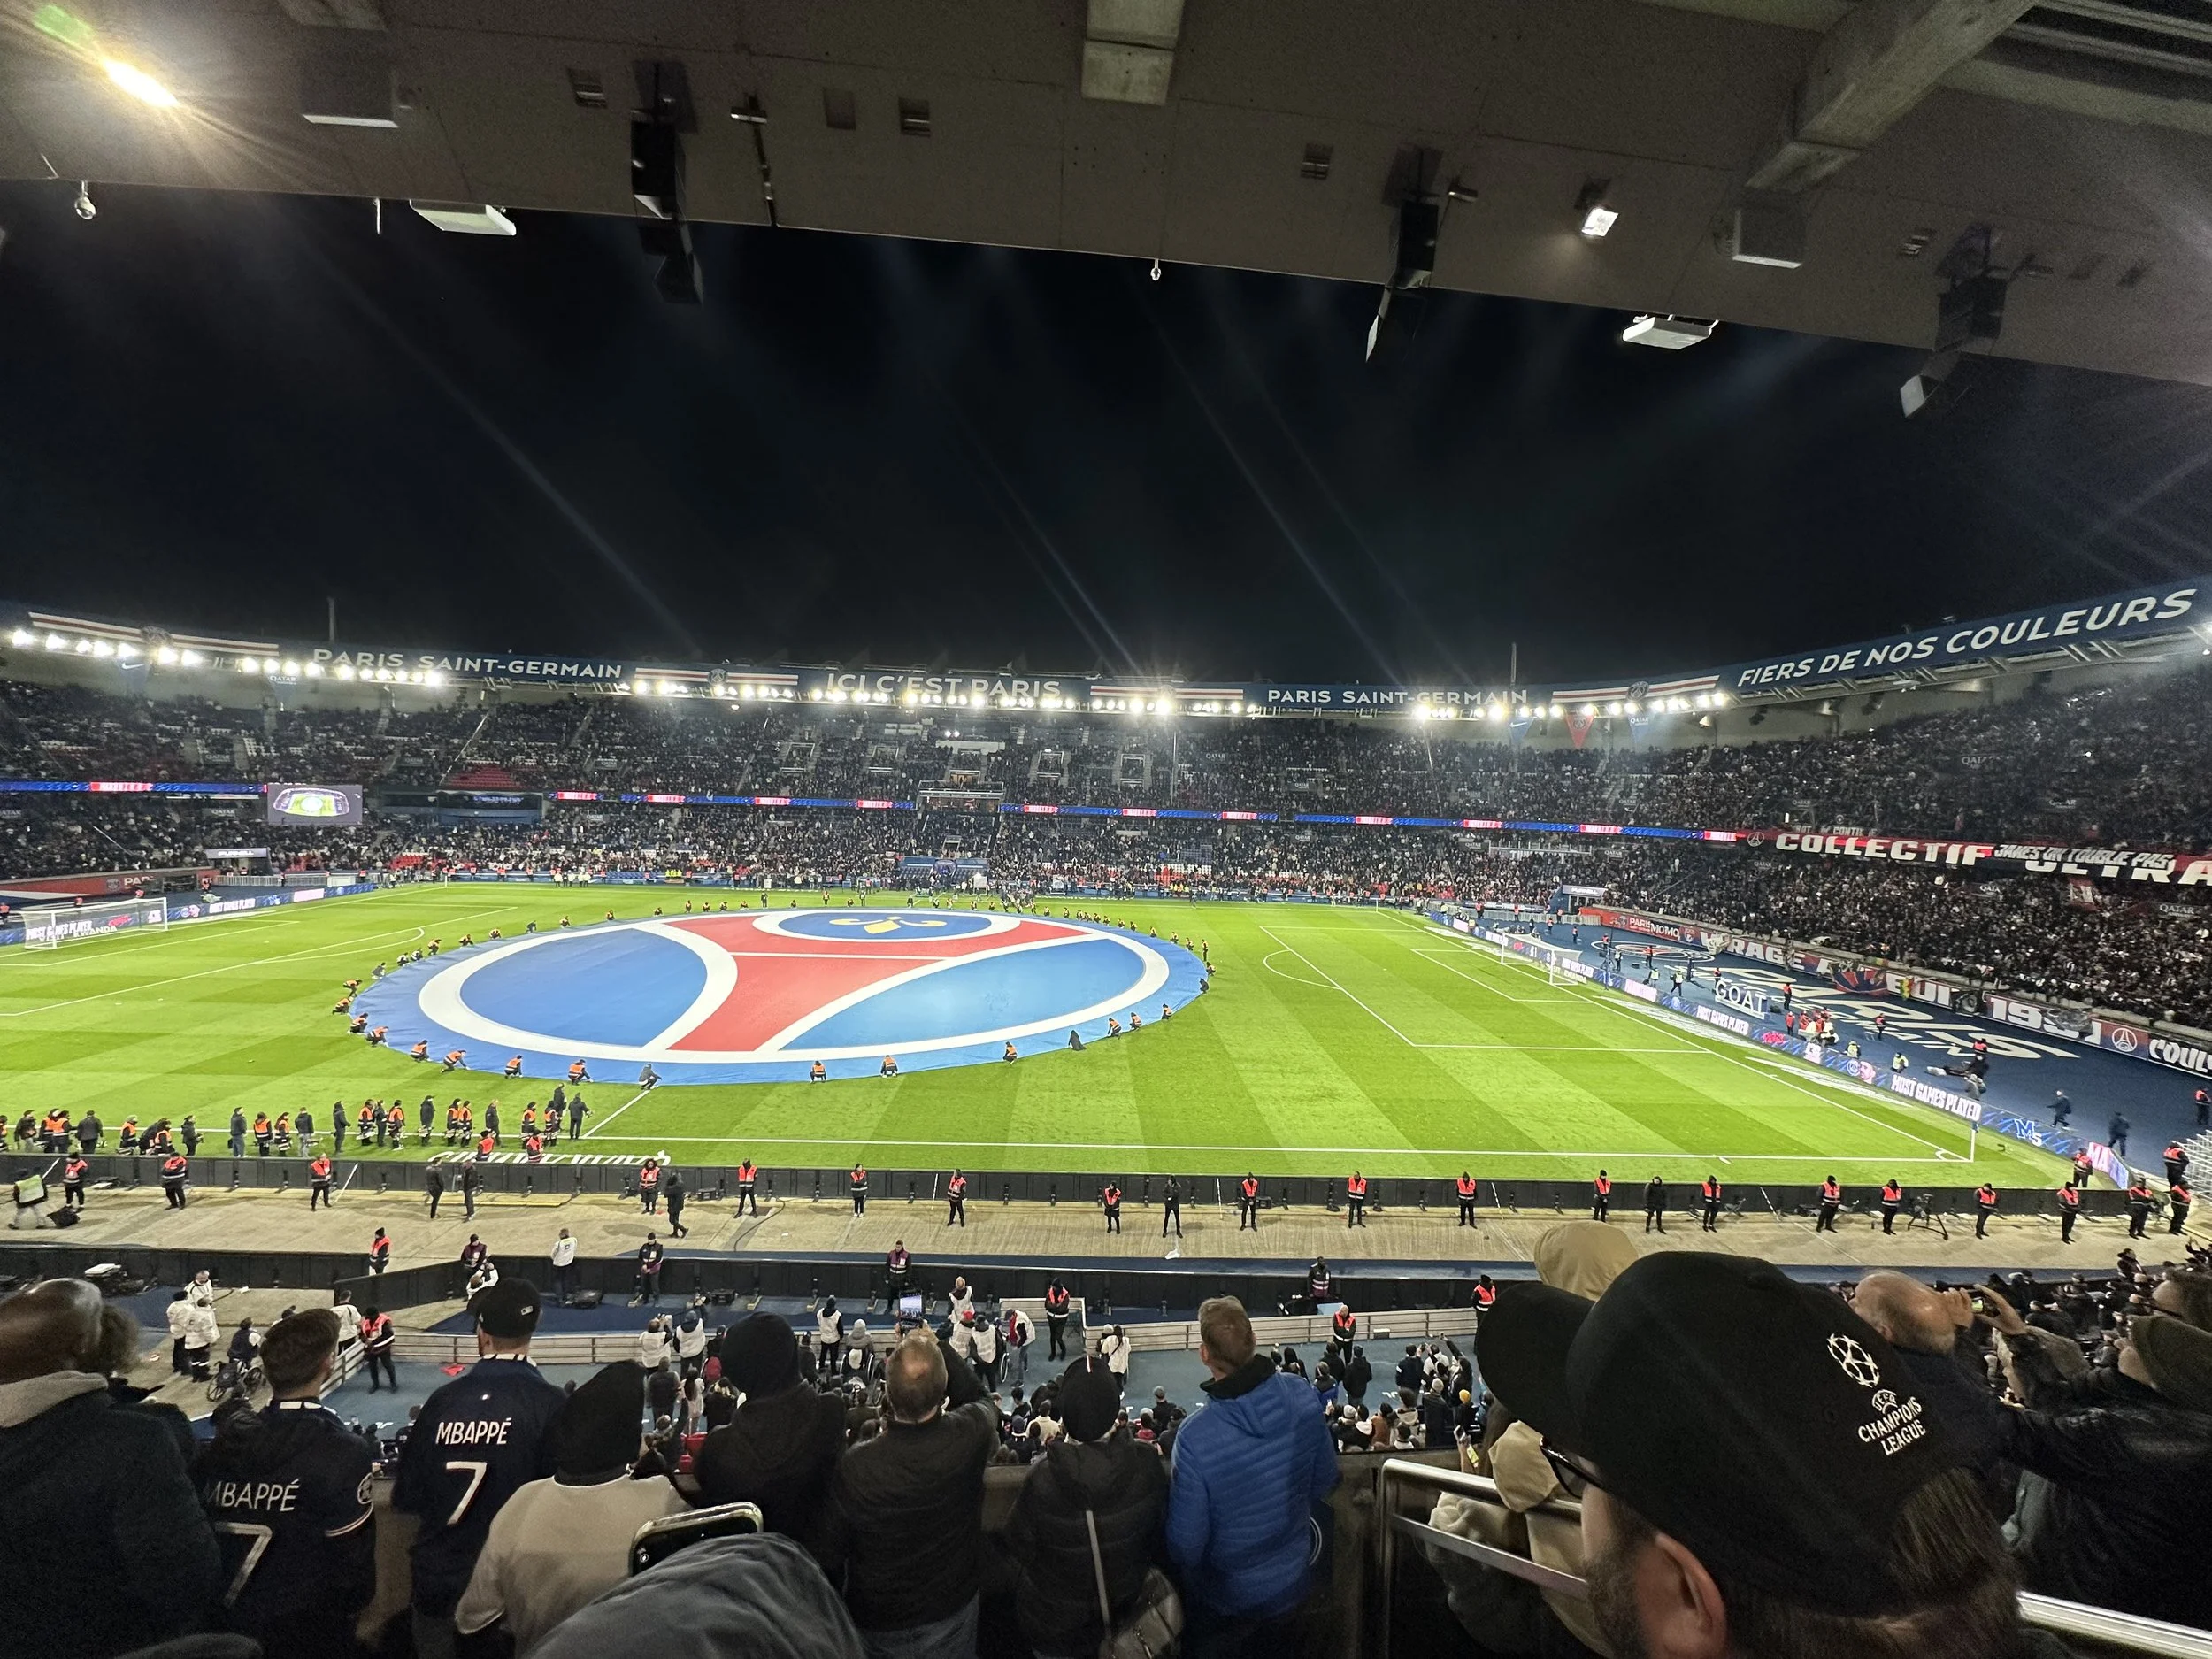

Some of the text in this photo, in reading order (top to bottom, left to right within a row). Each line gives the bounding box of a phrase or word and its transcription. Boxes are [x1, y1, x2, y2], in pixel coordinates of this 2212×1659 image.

[1738, 588, 2198, 687] FIERS DE NOS COULEURS
[313, 649, 622, 679] PARIS SAINT-GERMAIN
[826, 673, 1062, 697] ICI C'EST PARIS
[1268, 689, 1527, 705] PARIS SAINT-GERMAIN
[1775, 833, 1994, 866] COLLECTIF
[2131, 852, 2174, 869] PAS
[2160, 904, 2194, 914] QATAR
[1715, 980, 1767, 1014] GOAT
[1891, 1074, 1982, 1121] MOST GAMES PLAYED
[1873, 1392, 1897, 1412] UEFA
[435, 1417, 511, 1445] MBAPPÉ
[1858, 1396, 1922, 1443] CHAMPIONS
[1881, 1419, 1926, 1455] LEAGUE
[207, 1479, 299, 1512] MBAPPÉ
[446, 1461, 487, 1525] 7
[215, 1522, 273, 1606] 7
